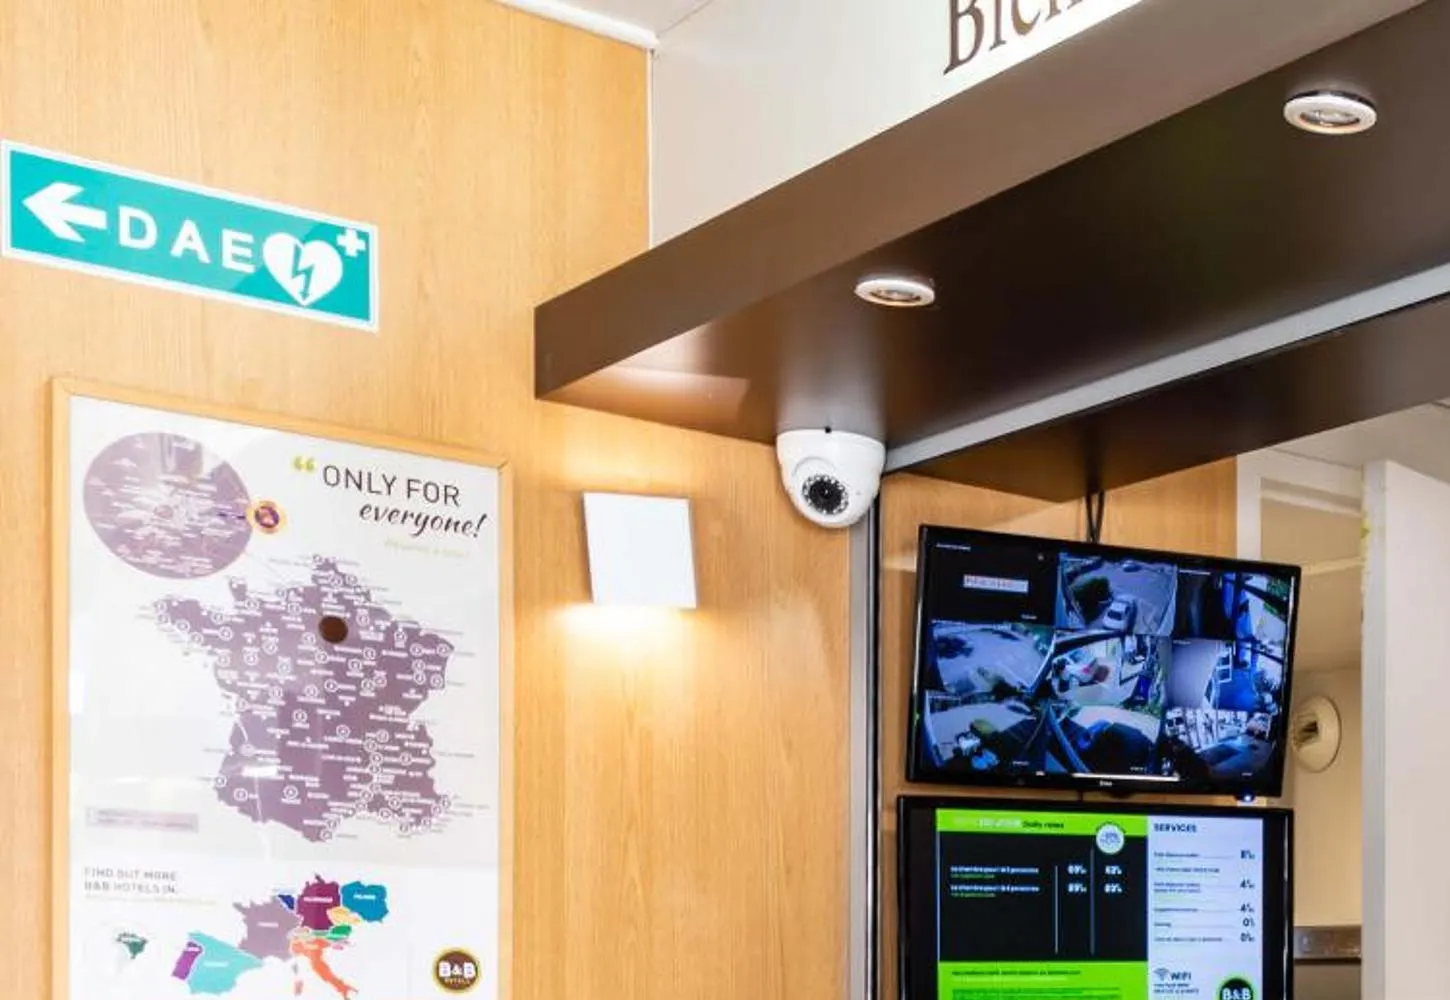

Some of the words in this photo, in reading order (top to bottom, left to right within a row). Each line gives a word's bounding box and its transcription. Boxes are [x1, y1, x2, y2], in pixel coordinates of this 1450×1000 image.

[118, 205, 255, 273] DAE
[323, 465, 397, 496] ONLY
[406, 478, 460, 507] FOR
[358, 502, 488, 538] everyone!
